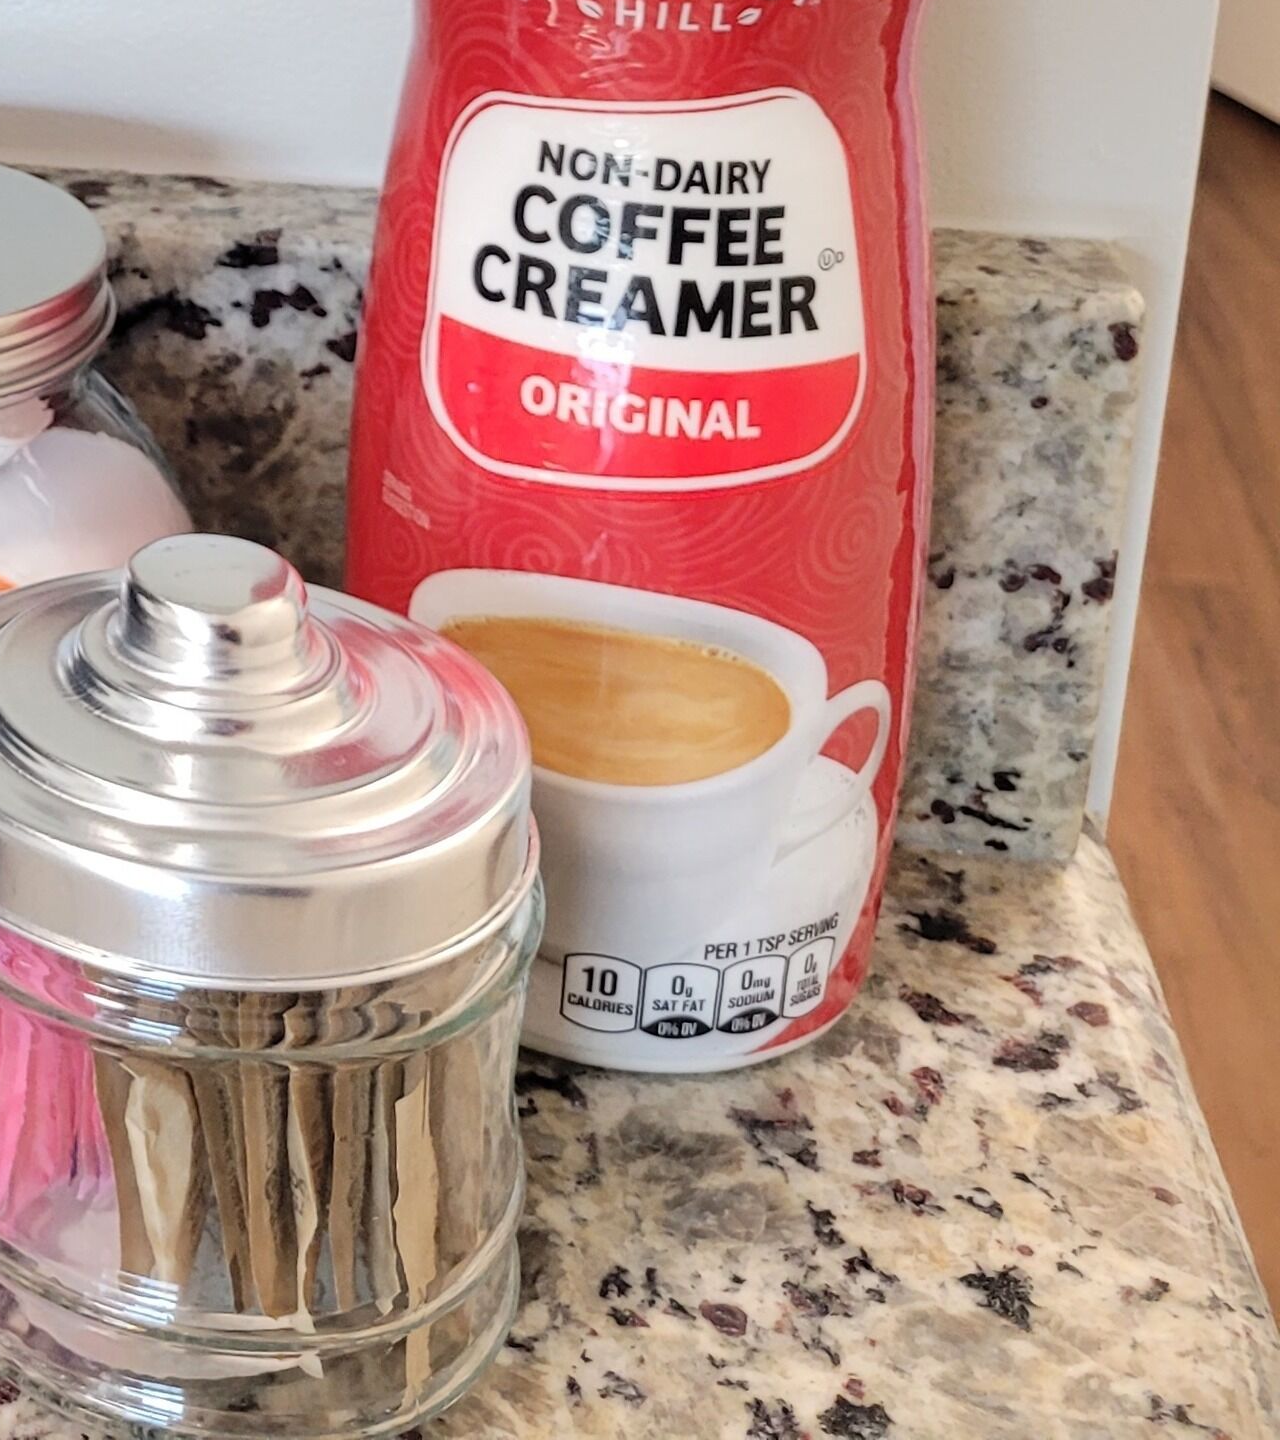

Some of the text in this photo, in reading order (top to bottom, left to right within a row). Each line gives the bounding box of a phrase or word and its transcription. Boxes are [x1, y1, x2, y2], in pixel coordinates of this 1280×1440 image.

[614, 0, 731, 32] HILL
[537, 140, 771, 195] NON-DAIRY
[513, 185, 785, 267] COFFEE
[472, 244, 819, 339] CREAMER
[520, 375, 761, 440] ORIGINAL
[704, 912, 839, 960] PER 1 TSP SERVING
[582, 965, 619, 997] 10
[727, 989, 775, 1009] SODIUM
[566, 991, 634, 1017] CALORIES
[651, 998, 707, 1012] SAT FAT
